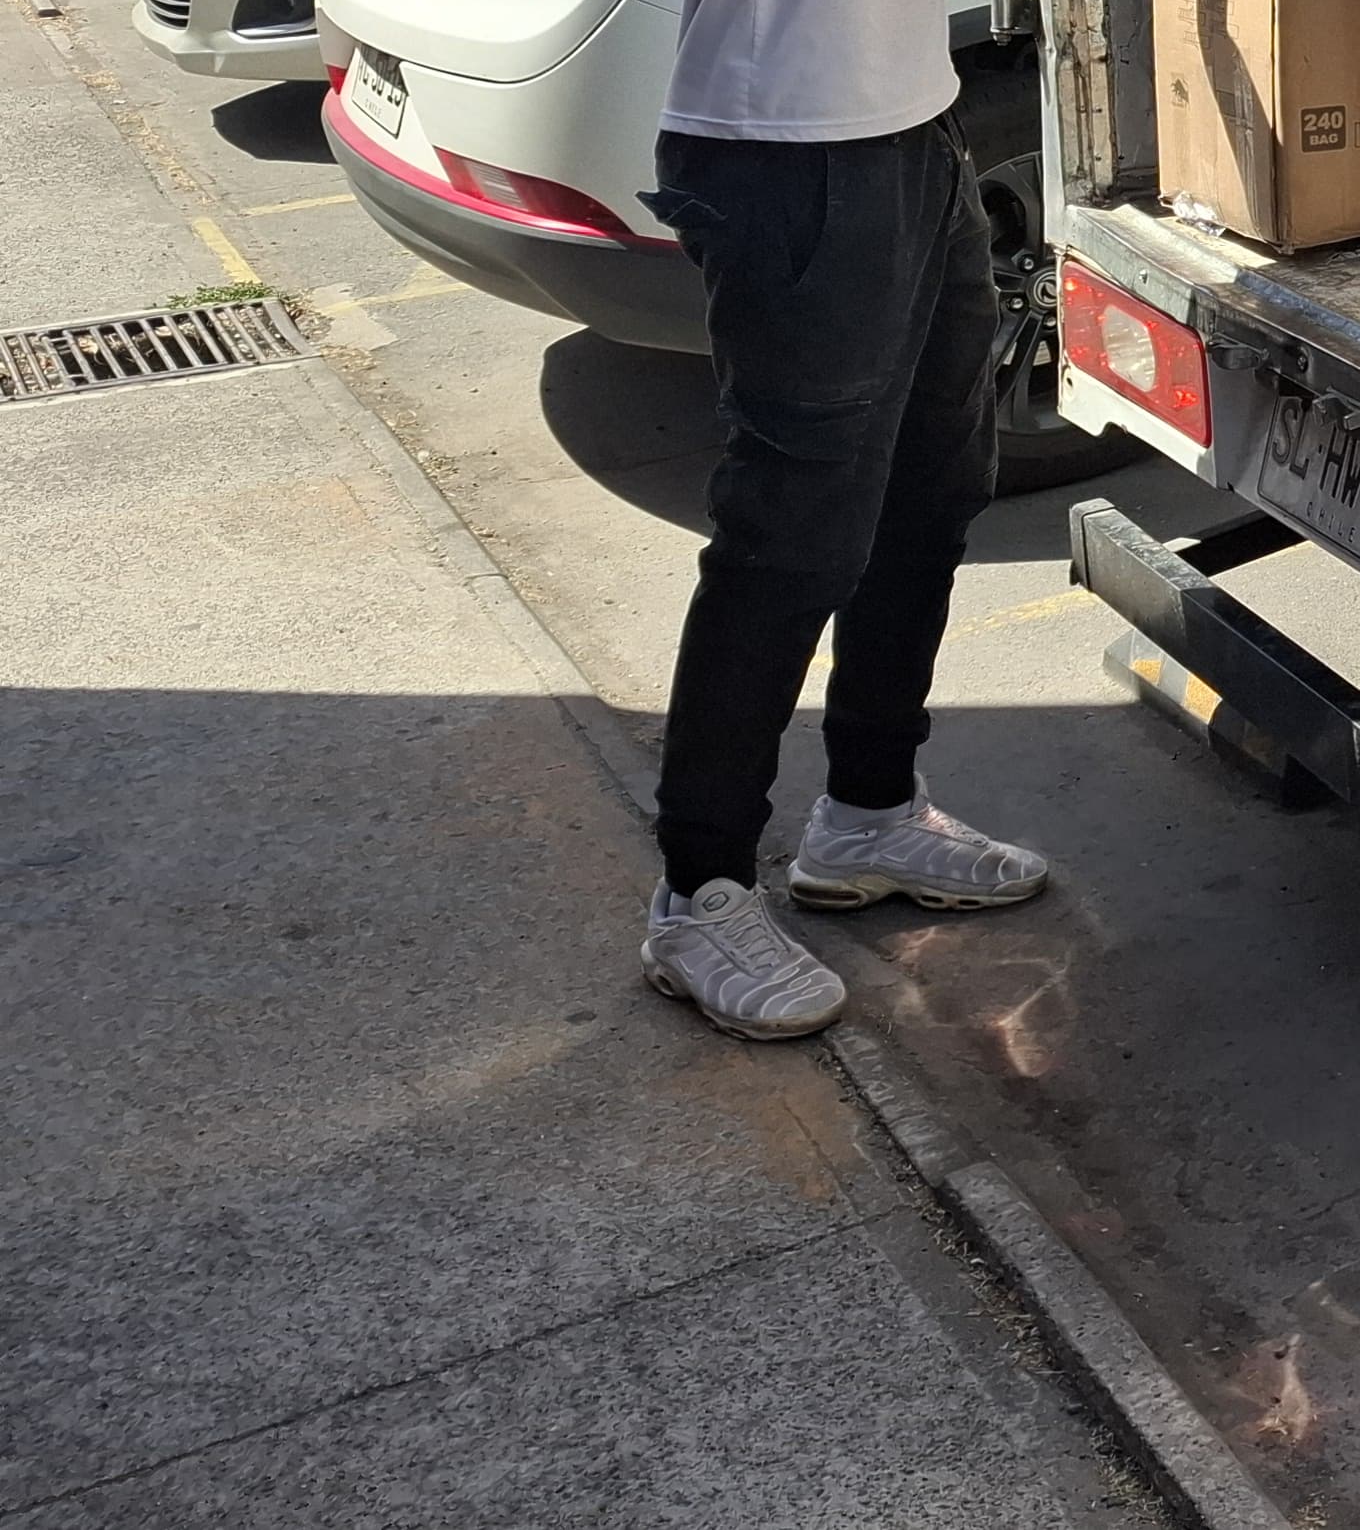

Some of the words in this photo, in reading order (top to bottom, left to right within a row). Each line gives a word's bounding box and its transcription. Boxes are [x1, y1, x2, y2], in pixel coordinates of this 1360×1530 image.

[1303, 111, 1343, 132] 240
[1309, 133, 1339, 146] BAG
[1306, 501, 1356, 543] CHILE
